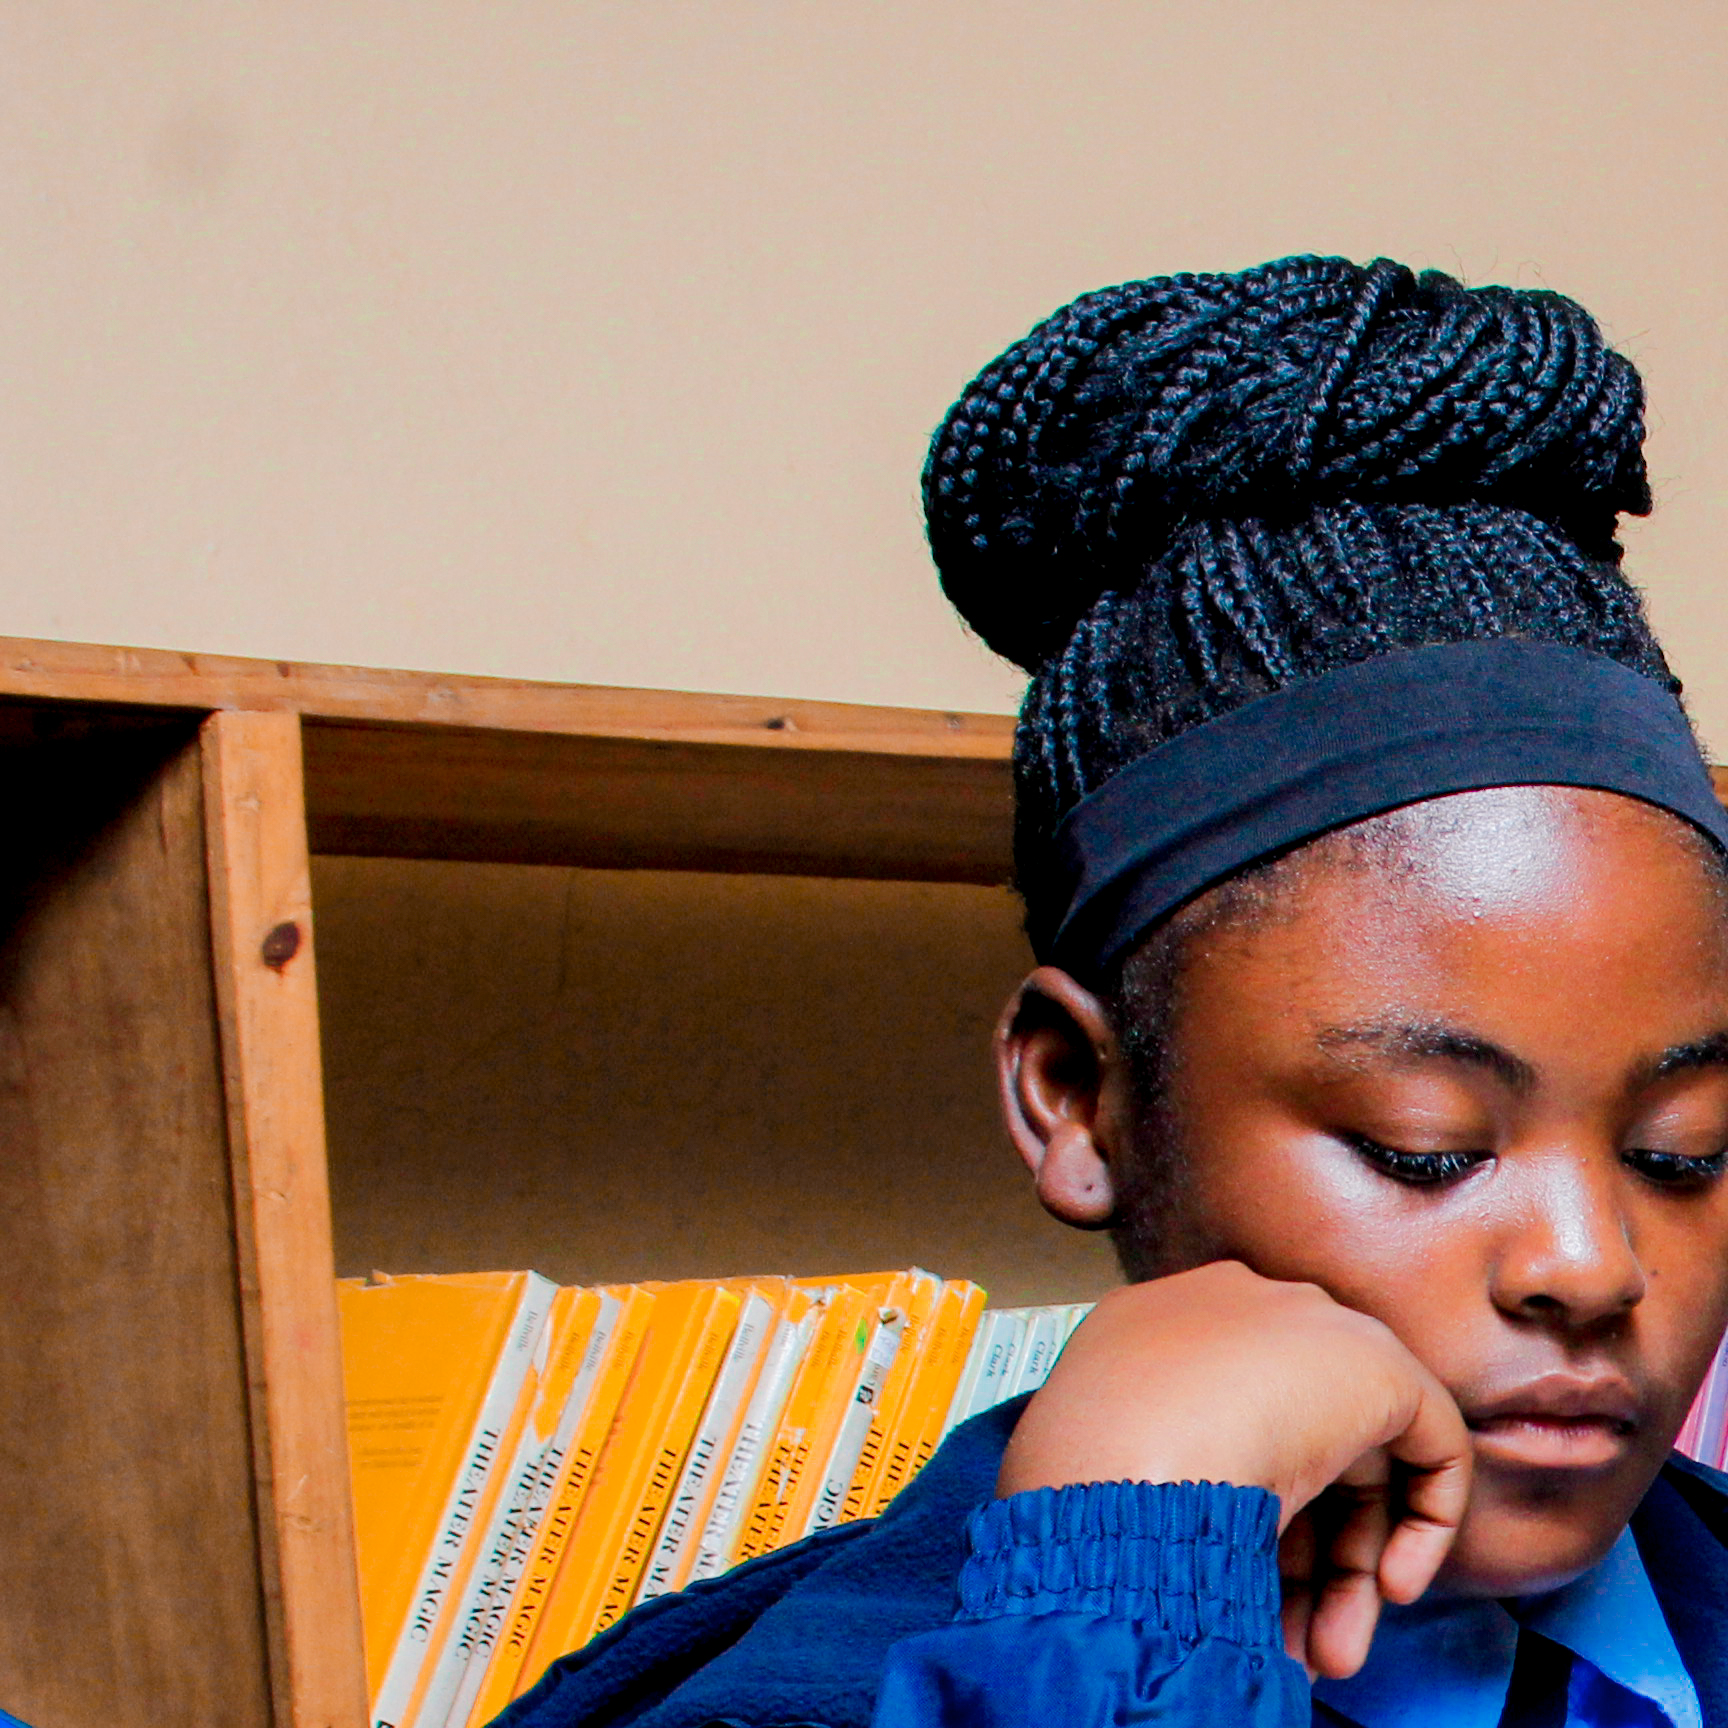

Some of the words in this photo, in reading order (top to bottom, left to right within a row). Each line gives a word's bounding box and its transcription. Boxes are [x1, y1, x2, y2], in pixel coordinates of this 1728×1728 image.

[985, 1344, 1003, 1377] Clark
[1029, 1341, 1046, 1376] Clark
[444, 1429, 500, 1549] THEATER
[540, 1449, 592, 1564] THEATER
[624, 1448, 677, 1563] THEATER
[662, 1437, 716, 1554] THEATER
[411, 1556, 452, 1643] MAGIC
[456, 1575, 497, 1660] MAGIC
[476, 1575, 517, 1659] MAGIC
[505, 1572, 547, 1658] MAGIC
[597, 1572, 629, 1633] MAG
